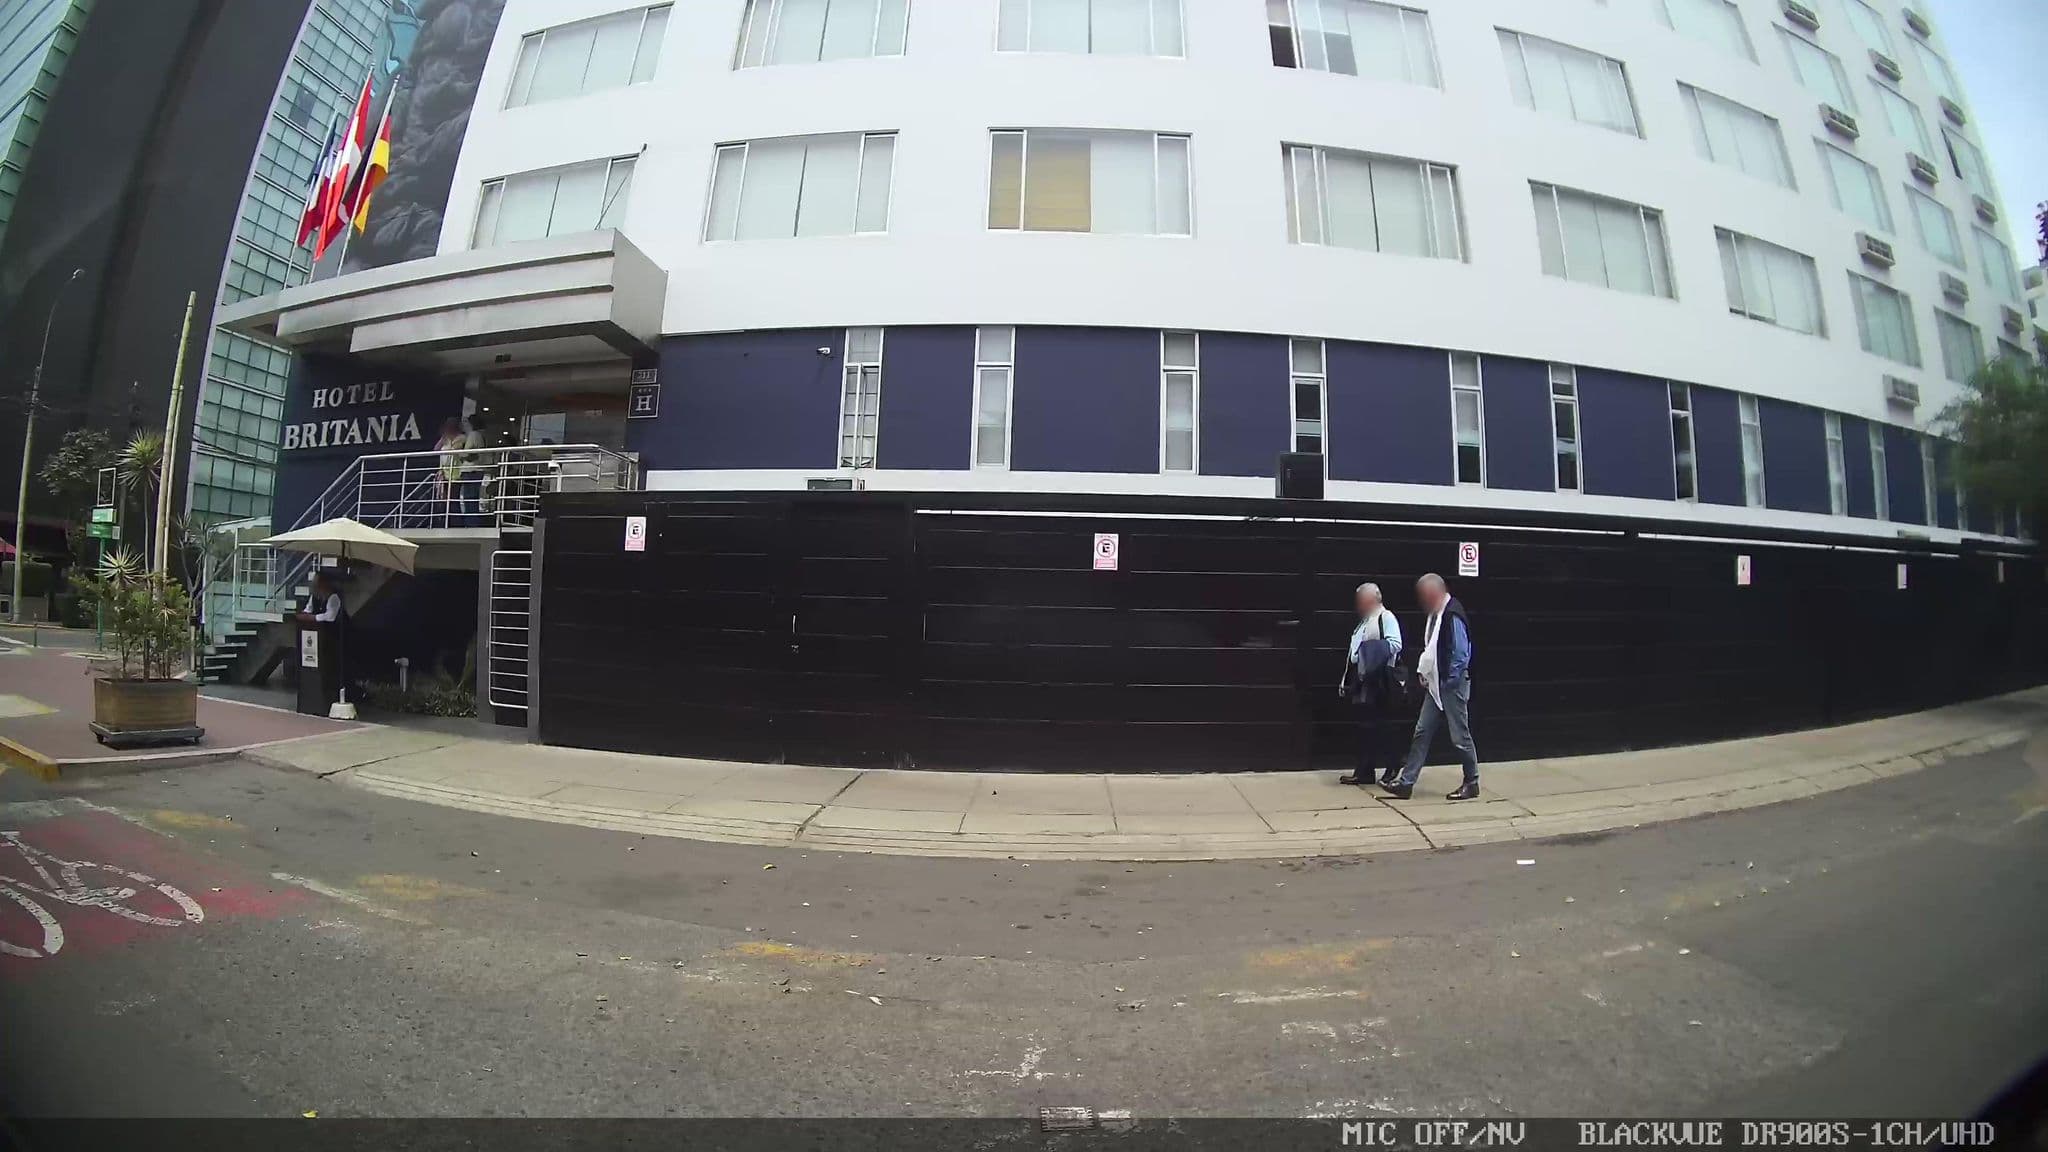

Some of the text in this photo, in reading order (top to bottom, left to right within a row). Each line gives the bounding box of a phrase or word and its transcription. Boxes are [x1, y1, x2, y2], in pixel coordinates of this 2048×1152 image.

[312, 381, 394, 408] HOTEL
[635, 395, 653, 411] H
[282, 412, 421, 450] BRITANIA
